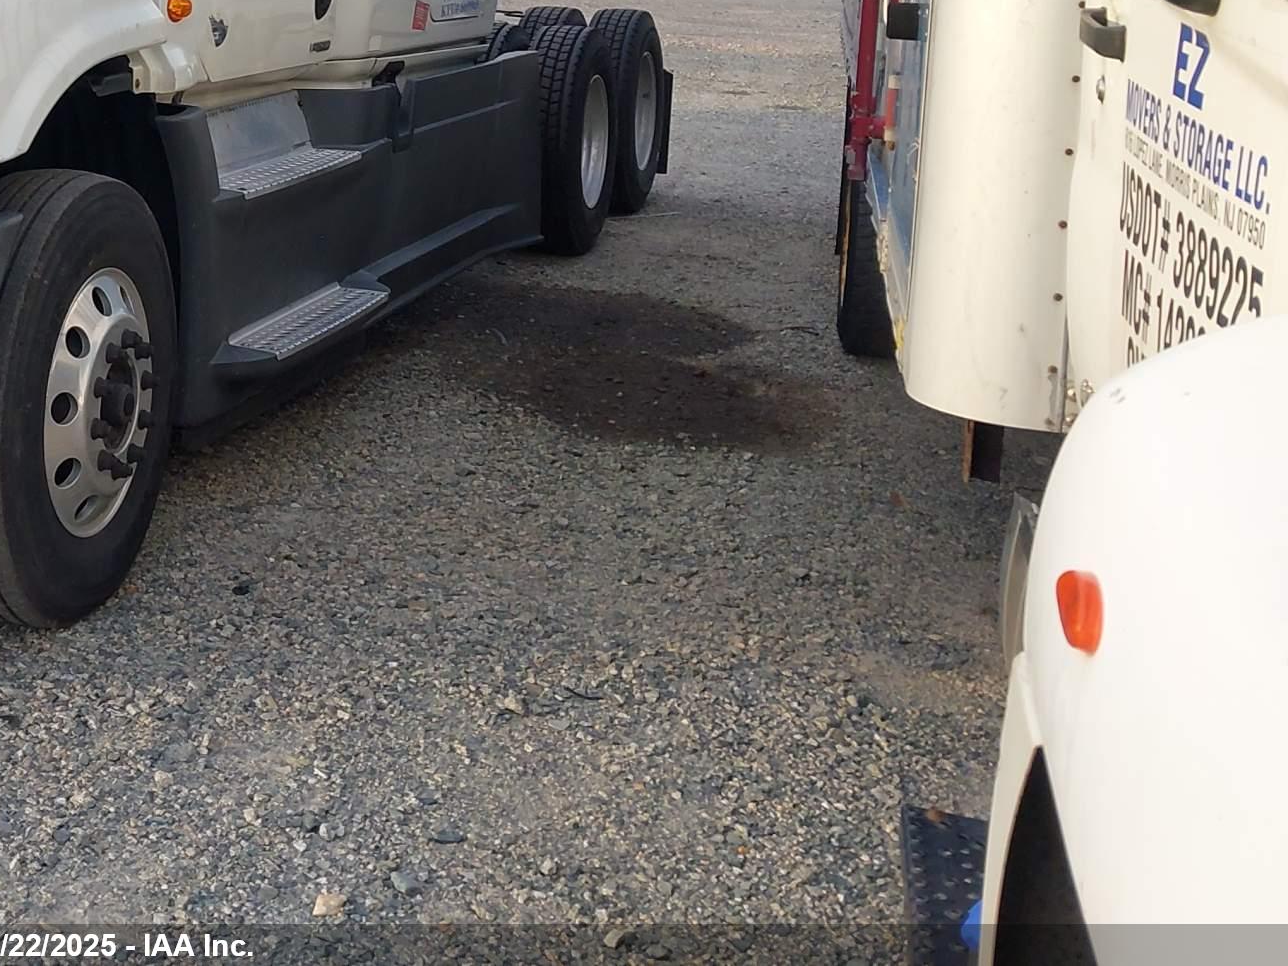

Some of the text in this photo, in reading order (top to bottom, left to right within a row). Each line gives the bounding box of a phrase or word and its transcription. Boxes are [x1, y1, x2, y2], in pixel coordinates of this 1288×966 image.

[1173, 22, 1211, 111] EZ
[1126, 78, 1271, 215] MOVERS & STORAGE LLC.
[1120, 161, 1264, 328] USDOT# 3889225
[1224, 198, 1236, 231] NJ
[1237, 207, 1266, 250] 07950
[1122, 249, 1152, 345] MC#
